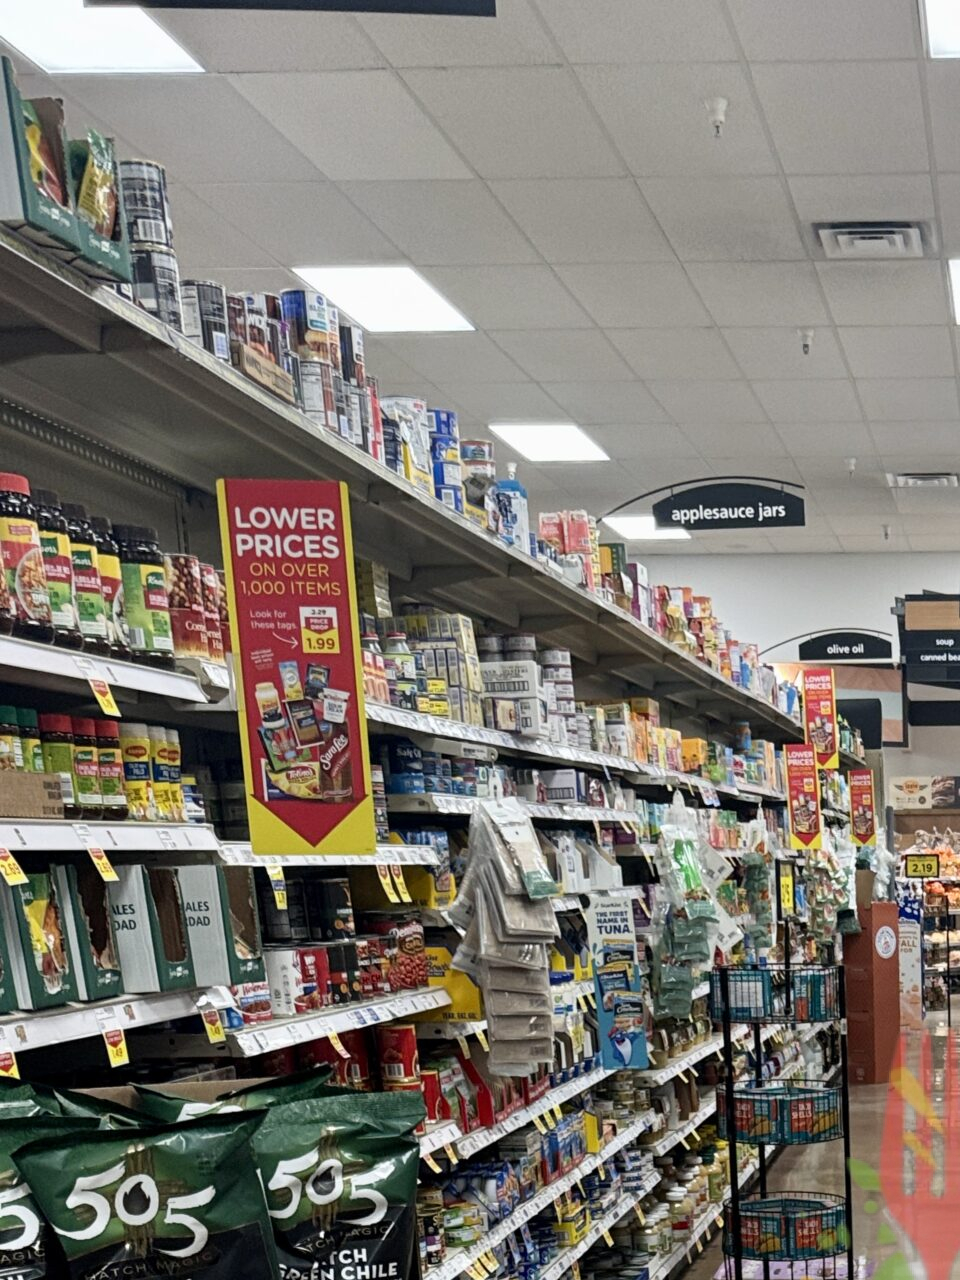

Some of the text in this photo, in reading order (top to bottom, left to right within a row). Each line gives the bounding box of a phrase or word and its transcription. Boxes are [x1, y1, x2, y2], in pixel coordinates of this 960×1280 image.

[235, 507, 335, 530] LOWER
[671, 502, 786, 524] applesauce jars
[236, 534, 339, 558] PRICES
[250, 562, 329, 577] ON OVER
[241, 581, 341, 596] 1,000 ITEMS
[250, 609, 286, 618] Look for
[251, 621, 275, 629] these
[306, 638, 334, 650] 1.99
[827, 643, 864, 654] olive oil
[936, 638, 954, 648] soup
[920, 653, 947, 661] canned
[912, 863, 933, 874] 2.19
[53, 1160, 216, 1258] 505
[340, 1262, 398, 1280] CHILE
